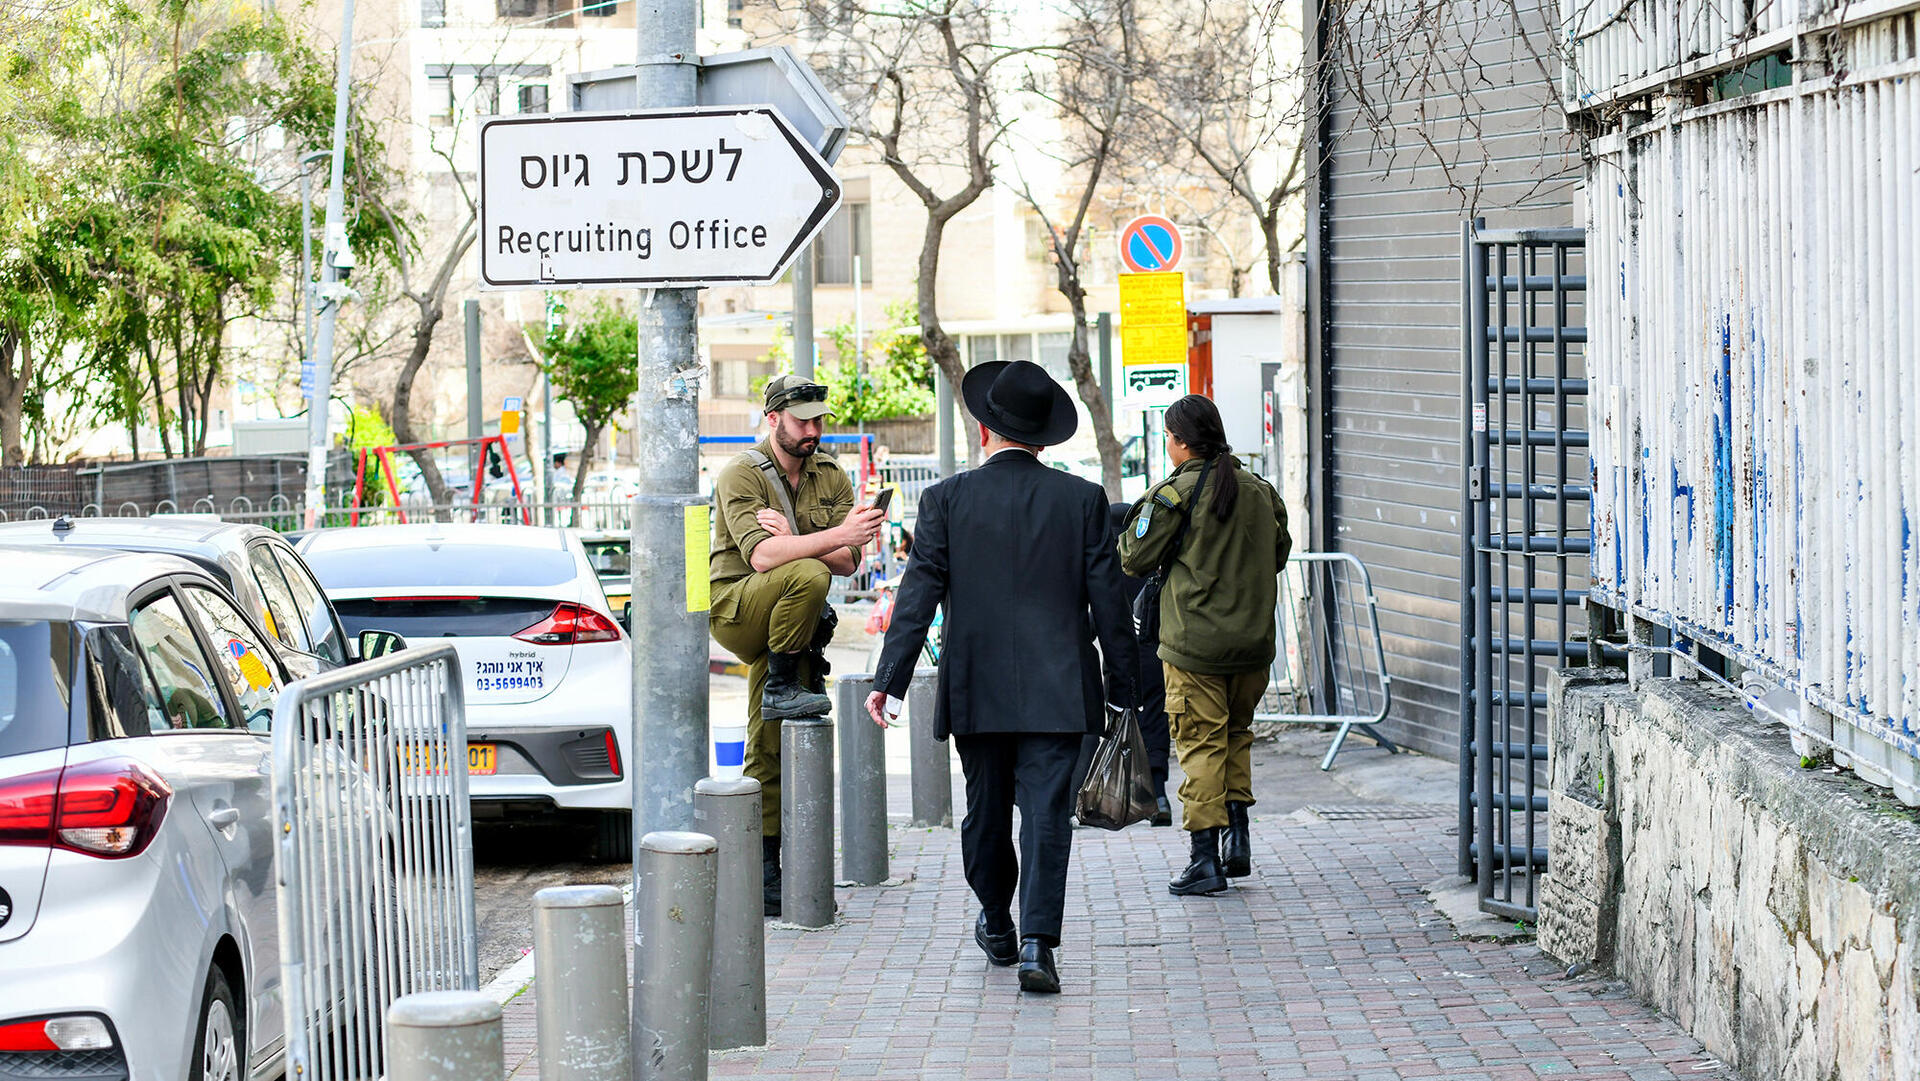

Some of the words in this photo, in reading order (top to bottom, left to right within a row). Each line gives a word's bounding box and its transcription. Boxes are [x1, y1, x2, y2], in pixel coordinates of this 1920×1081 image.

[617, 138, 743, 186] לשכת
[520, 153, 590, 189] גיוס
[498, 220, 652, 260] Recruiting
[669, 219, 768, 250] Office
[509, 651, 536, 659] hybrid
[476, 662, 504, 674] נוהג?
[507, 662, 523, 673] אני
[526, 661, 544, 675] איך
[476, 676, 544, 690] 03-5699403
